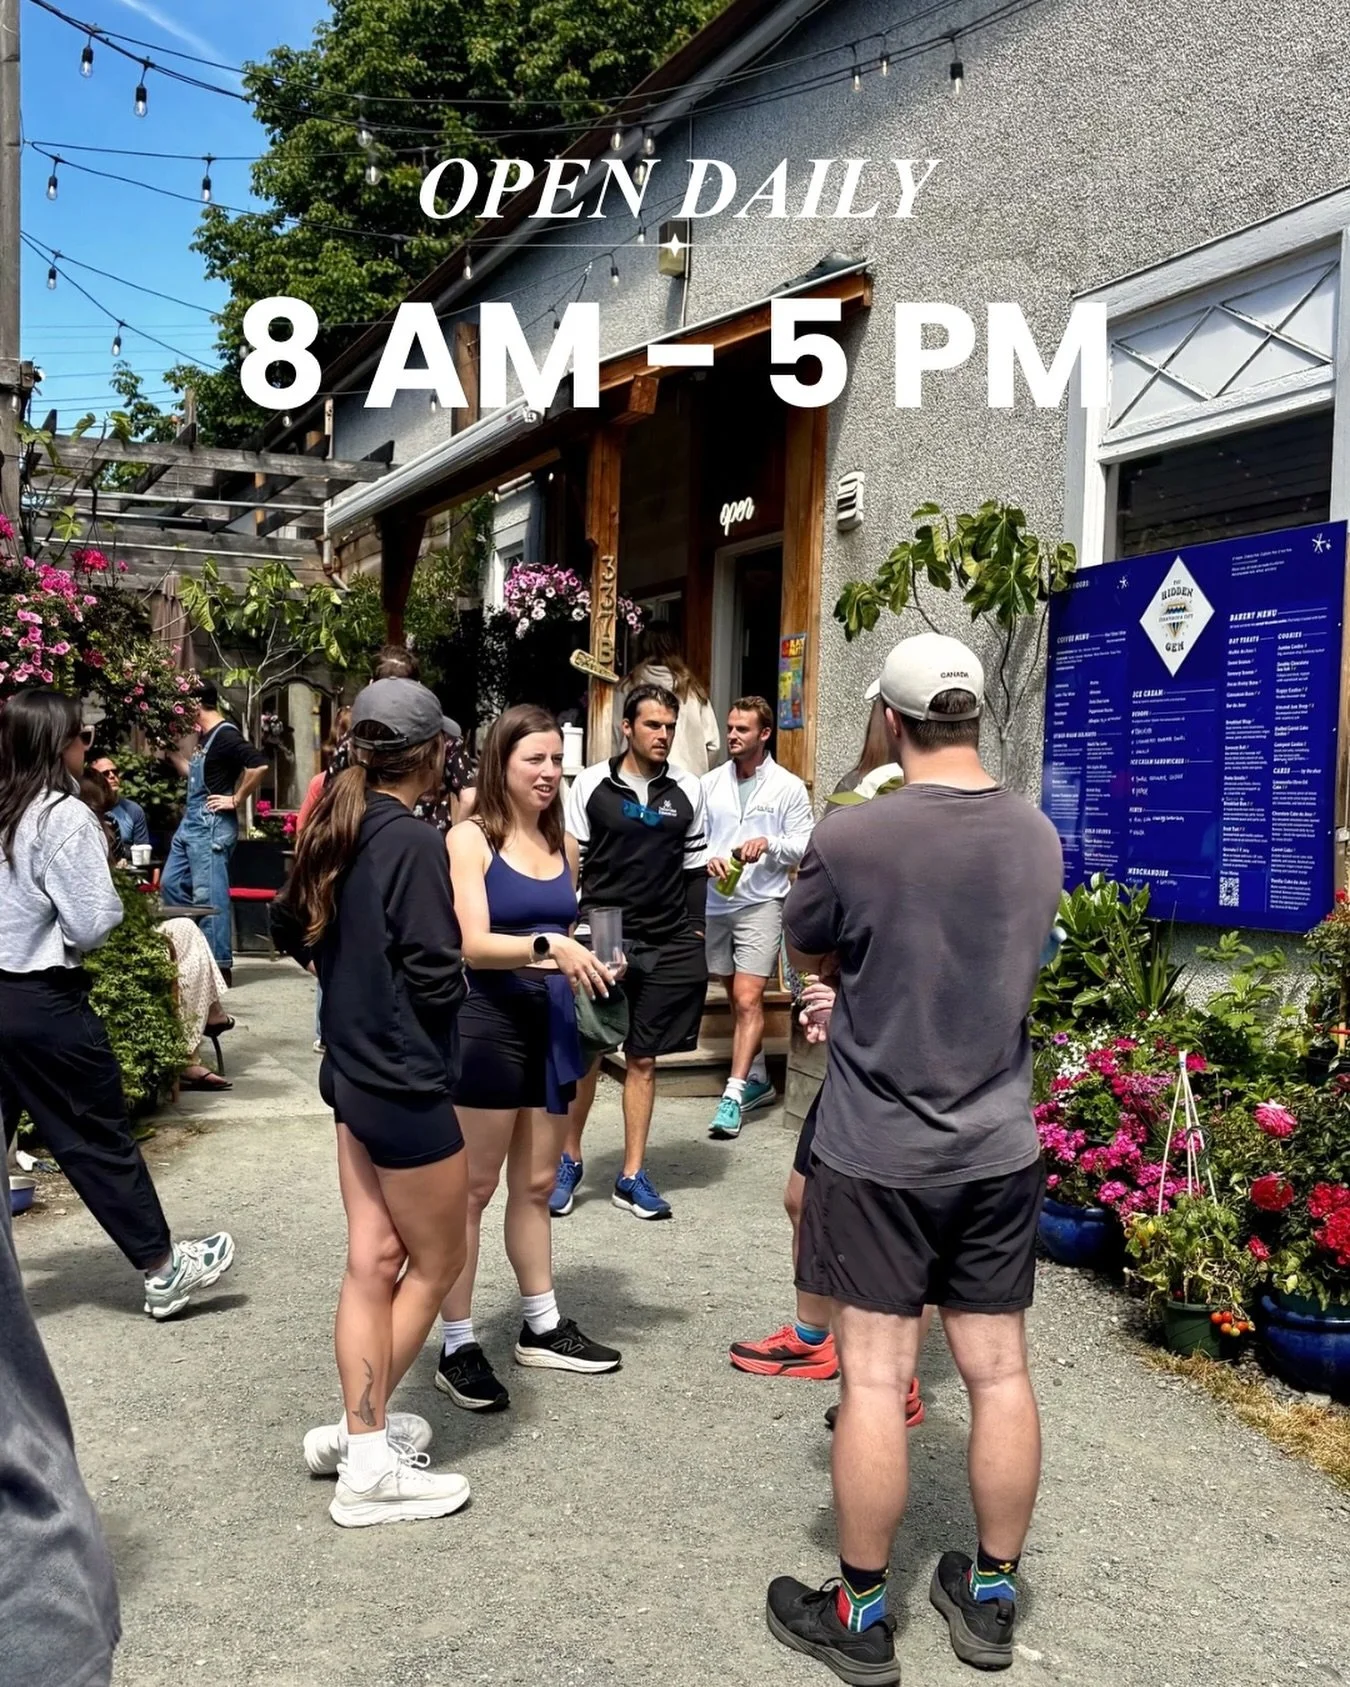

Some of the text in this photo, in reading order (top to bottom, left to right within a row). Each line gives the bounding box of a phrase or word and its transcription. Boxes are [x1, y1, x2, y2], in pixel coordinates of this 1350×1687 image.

[719, 496, 755, 536] open
[1161, 586, 1194, 601] HIDDEN
[1230, 611, 1255, 622] BAKERY
[1256, 609, 1277, 619] MENU
[1277, 631, 1302, 640] COOKIES
[1165, 641, 1185, 653] GEM
[940, 671, 969, 679] CANADA
[1143, 689, 1163, 697] CREAM
